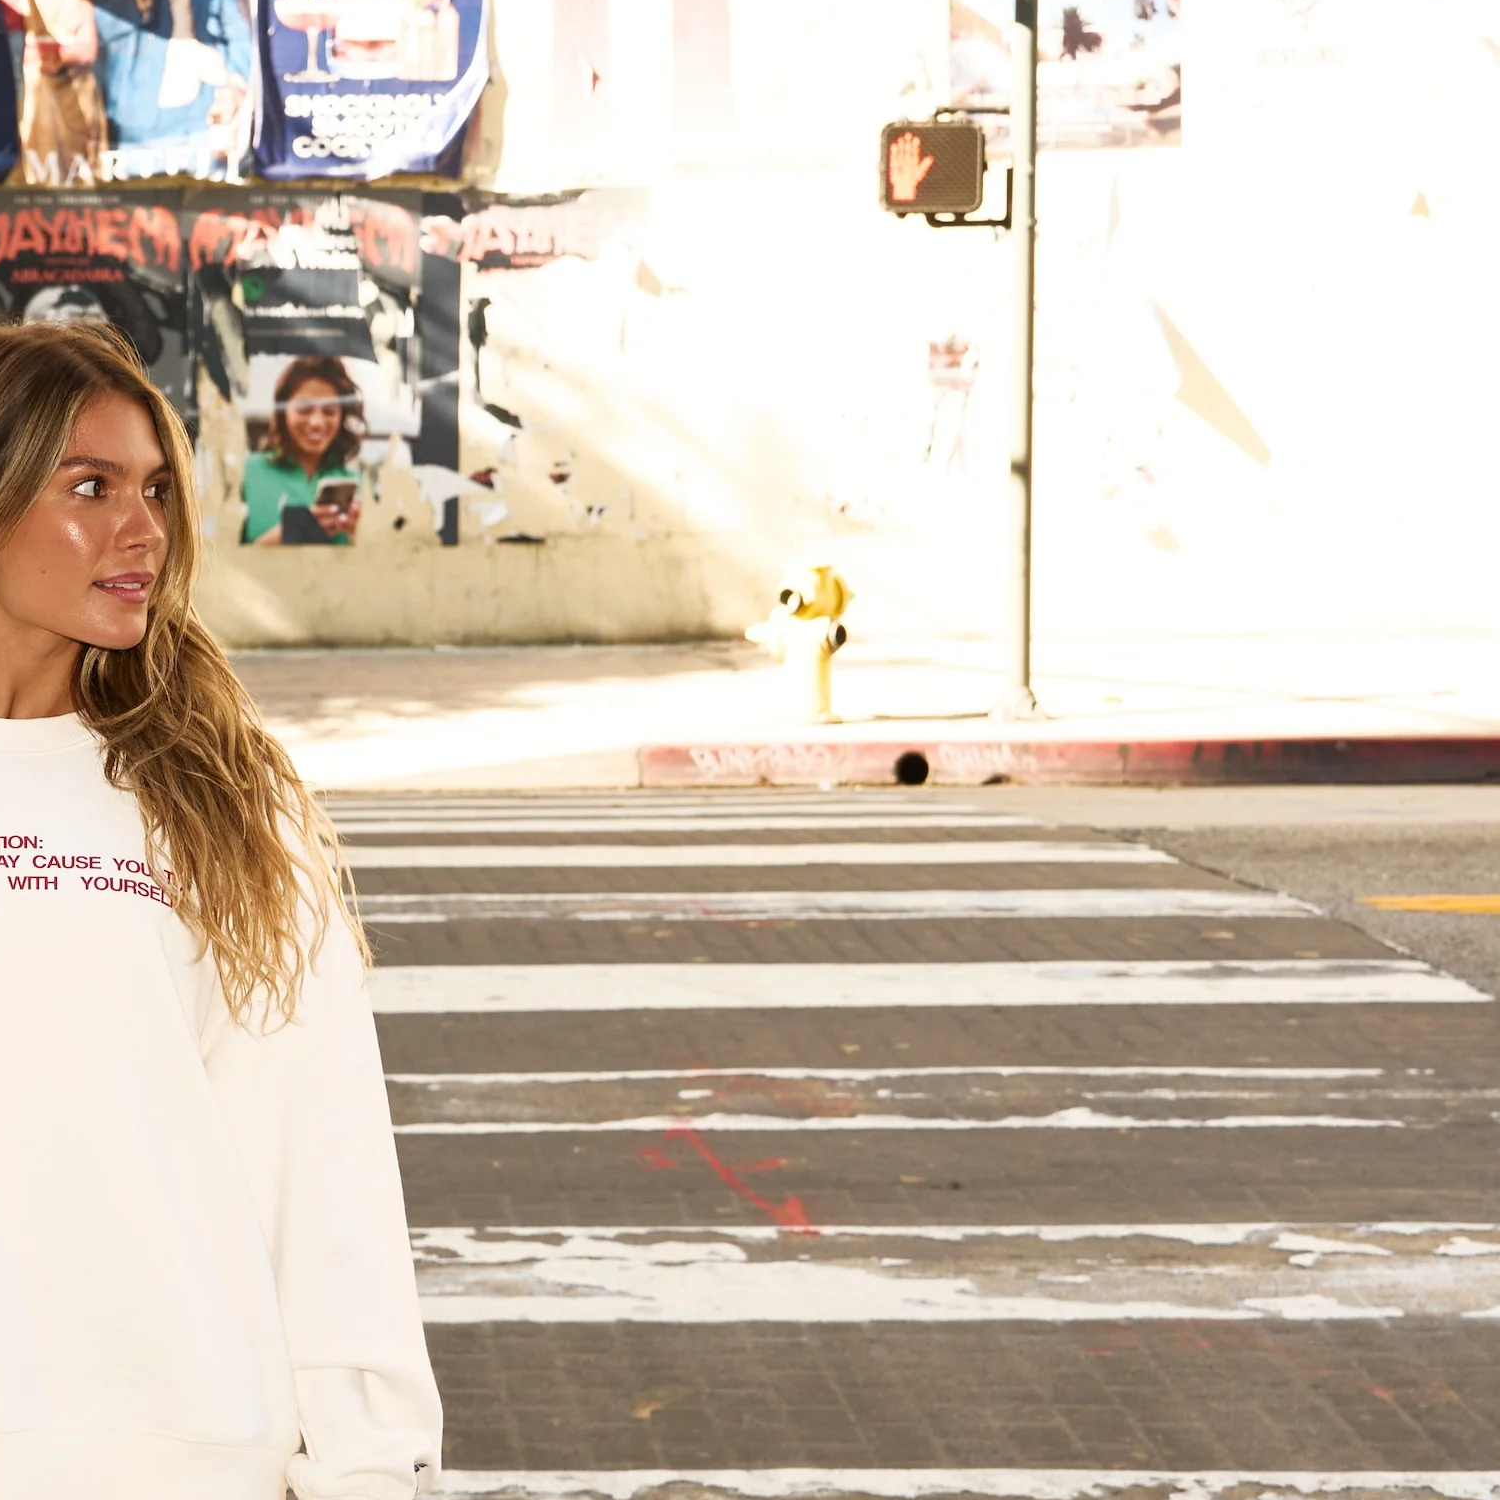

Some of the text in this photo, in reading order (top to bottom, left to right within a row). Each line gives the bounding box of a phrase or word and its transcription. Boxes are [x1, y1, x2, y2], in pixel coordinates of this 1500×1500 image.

[32, 855, 102, 870] CAUSE
[112, 857, 153, 878] YOU
[8, 876, 58, 891] WITH
[80, 876, 174, 909] YOURSEL
